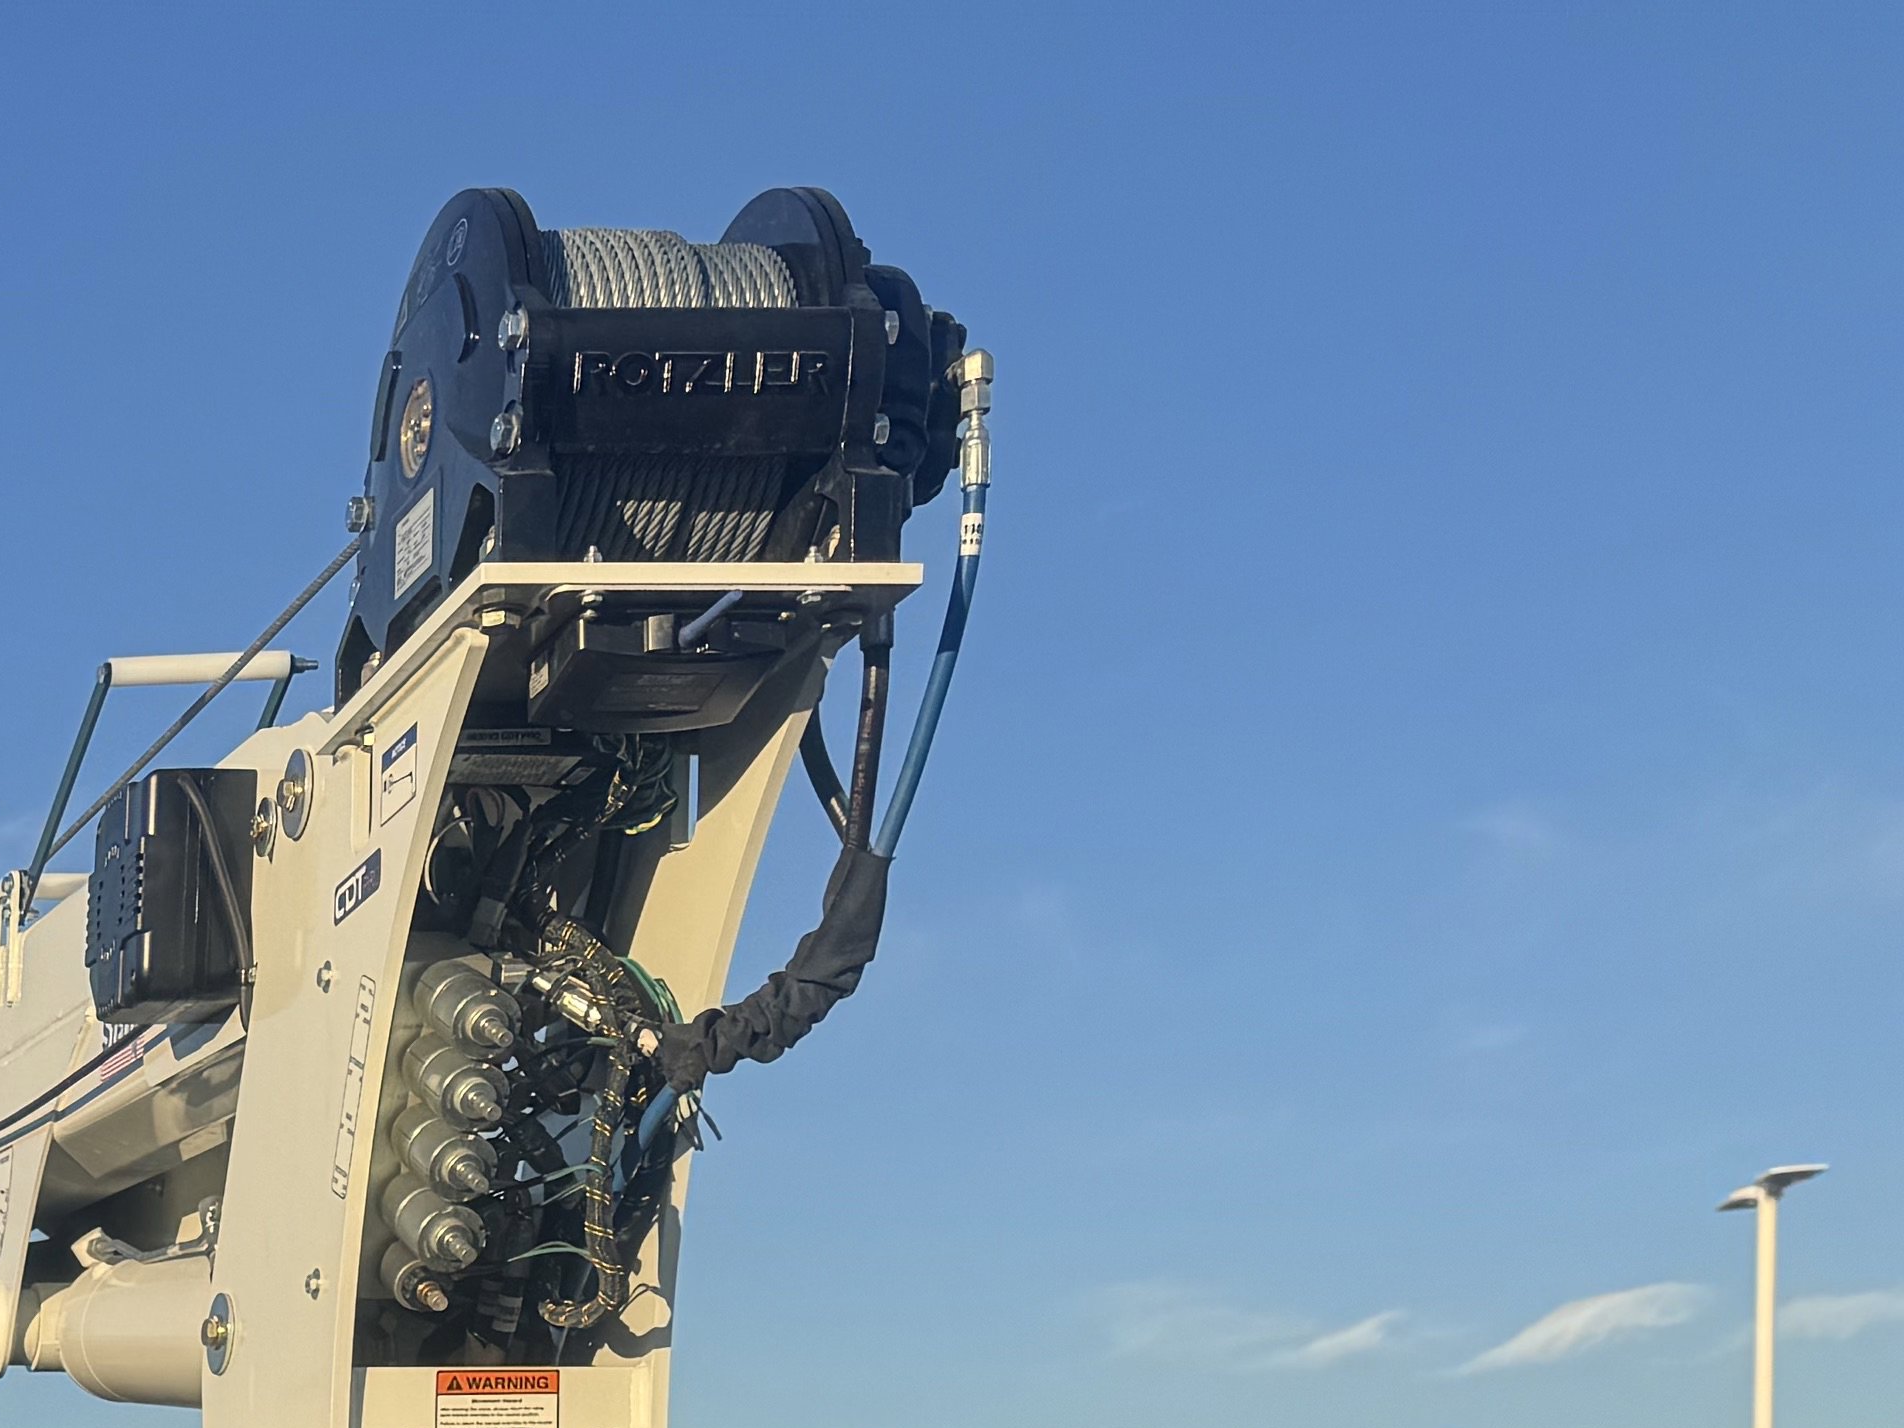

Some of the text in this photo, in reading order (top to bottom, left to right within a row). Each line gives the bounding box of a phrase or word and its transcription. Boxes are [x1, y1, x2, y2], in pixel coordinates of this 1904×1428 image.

[572, 351, 831, 396] ROTZLER
[335, 865, 366, 919] CDT
[466, 1376, 549, 1389] WARNING
